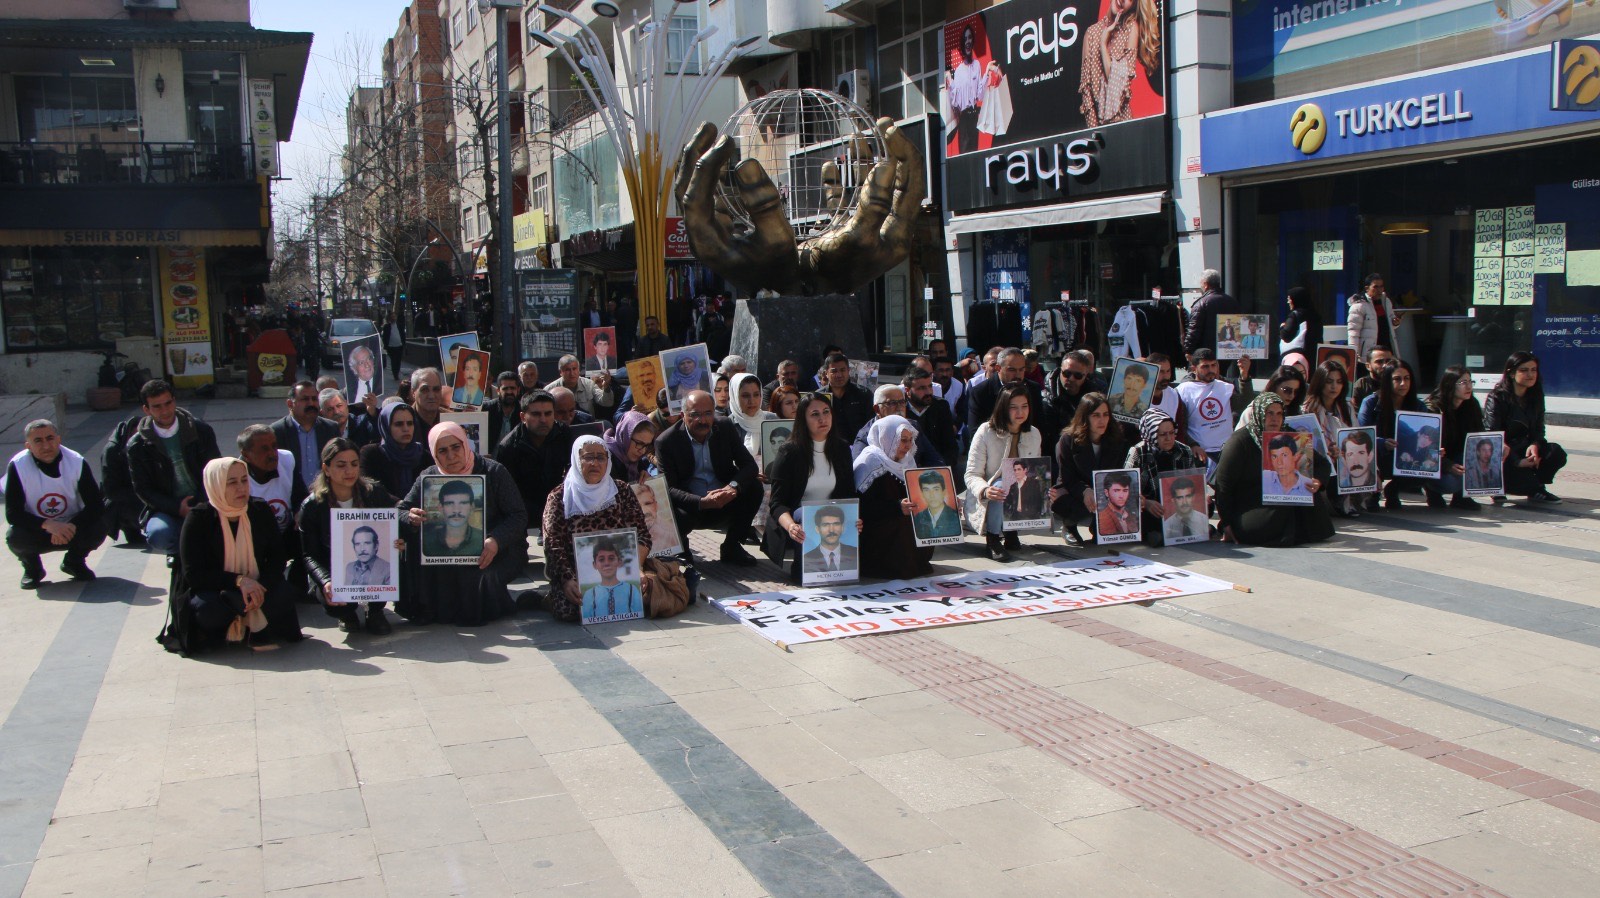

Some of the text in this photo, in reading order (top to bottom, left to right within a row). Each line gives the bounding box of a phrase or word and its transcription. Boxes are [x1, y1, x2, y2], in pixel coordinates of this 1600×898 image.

[1006, 6, 1079, 64] rays
[1335, 89, 1472, 137] TURKCELL
[985, 139, 1093, 190] rays
[64, 230, 181, 243] ŞEHİR SOFRASI
[668, 233, 688, 243] Col
[1315, 241, 1338, 254] 532
[992, 250, 1019, 269] BÜYÜK
[1007, 270, 1027, 284] SONU
[1536, 328, 1567, 336] paycell
[337, 511, 396, 522] İBRAHİM ÇELİK
[777, 566, 1101, 606] Kayıplar Bulunsun
[748, 570, 1190, 628] Failler Yargılansın
[889, 603, 1048, 627] Batman
[1052, 585, 1184, 609] Şubesi
